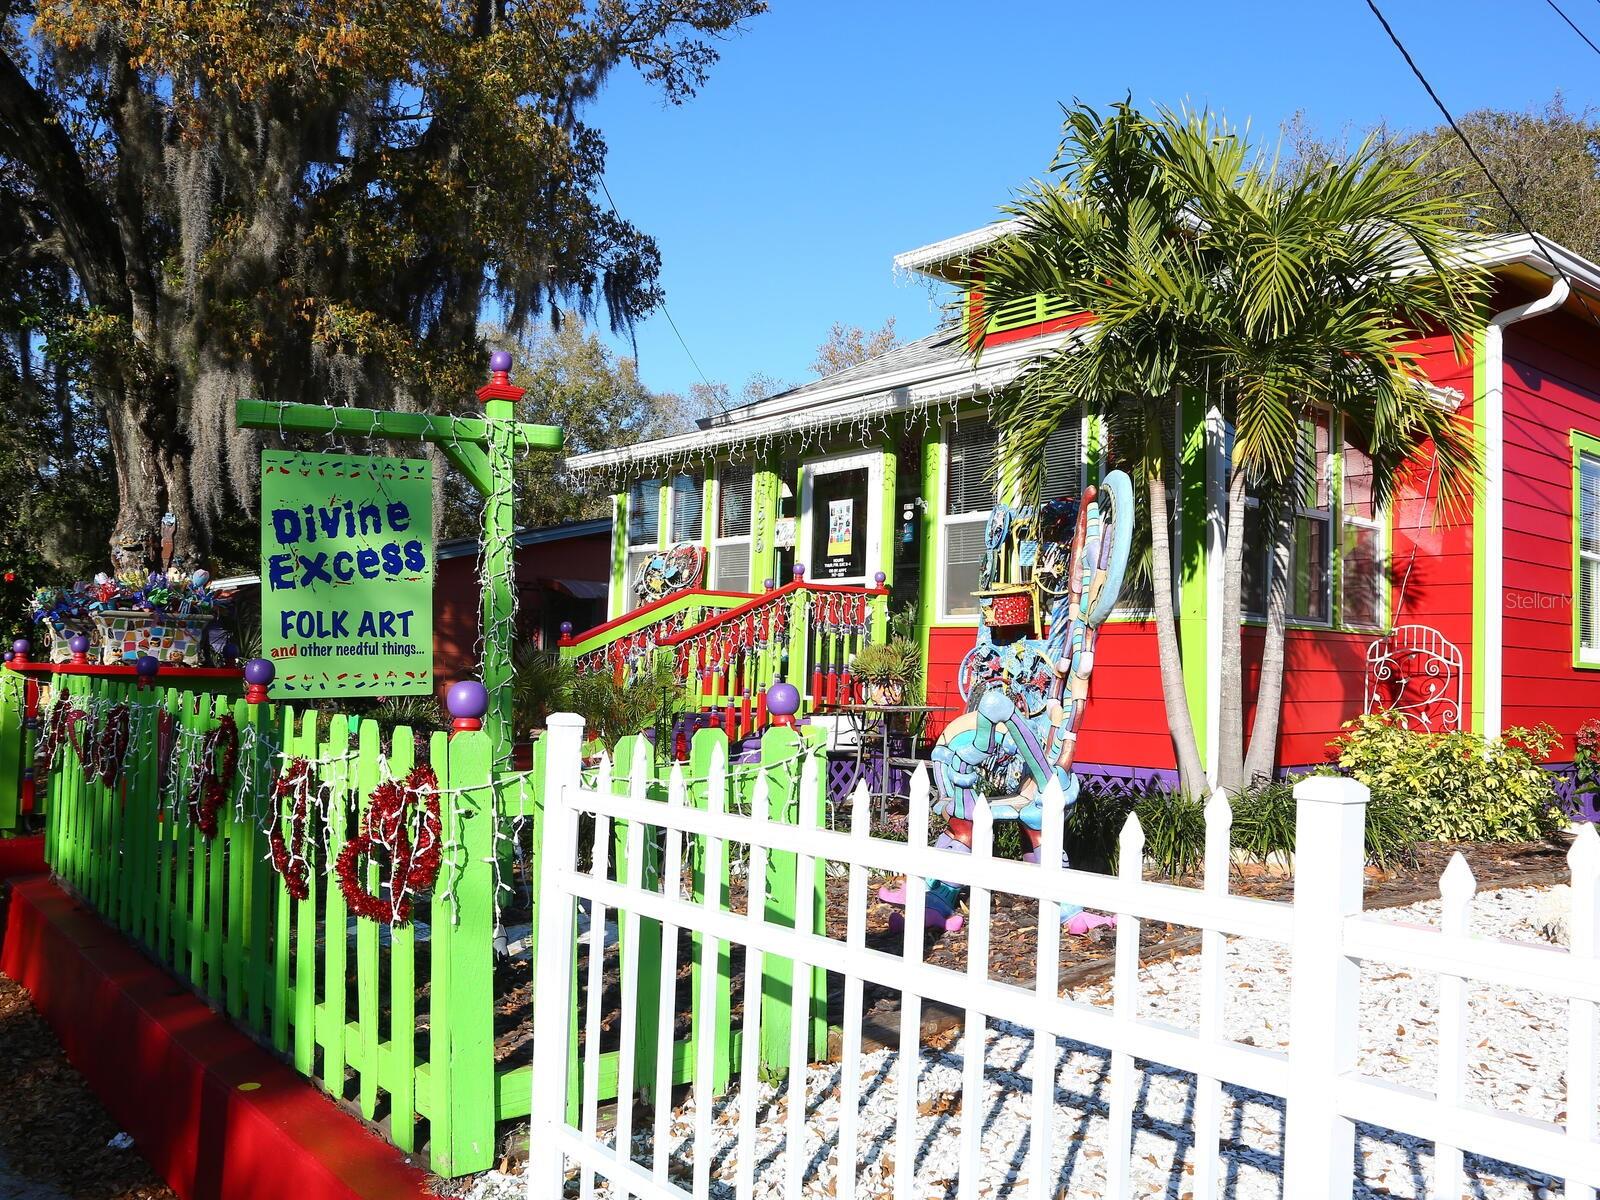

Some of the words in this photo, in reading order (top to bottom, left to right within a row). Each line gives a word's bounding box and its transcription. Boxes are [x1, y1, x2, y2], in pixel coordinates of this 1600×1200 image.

[271, 500, 410, 544] Divine
[280, 610, 349, 639] FOLK
[357, 610, 414, 638] ART
[270, 643, 298, 658] and
[300, 641, 333, 657] other
[336, 641, 379, 657] needful
[382, 641, 425, 657] things...
